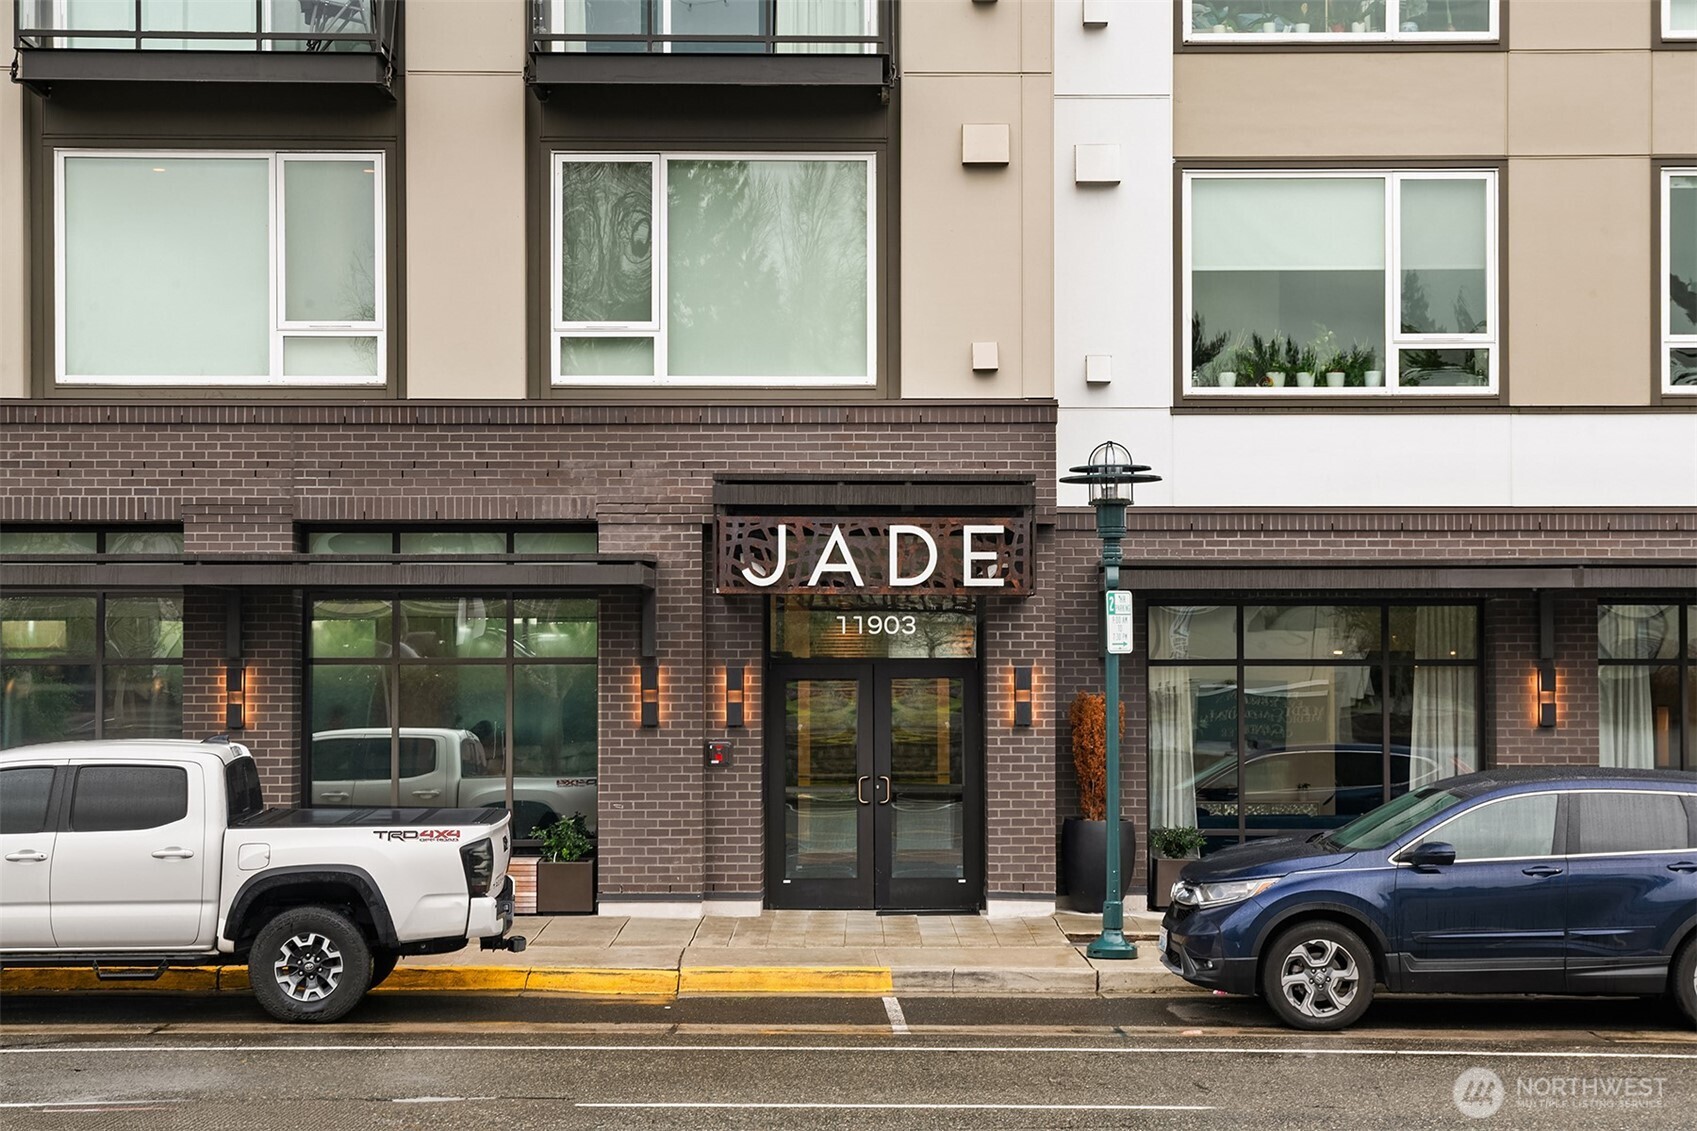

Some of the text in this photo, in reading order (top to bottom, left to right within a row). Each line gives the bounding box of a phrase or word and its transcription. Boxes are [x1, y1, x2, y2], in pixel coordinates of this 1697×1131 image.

[741, 524, 1004, 587] JADE
[1109, 596, 1114, 611] 2
[836, 615, 916, 635] 11903
